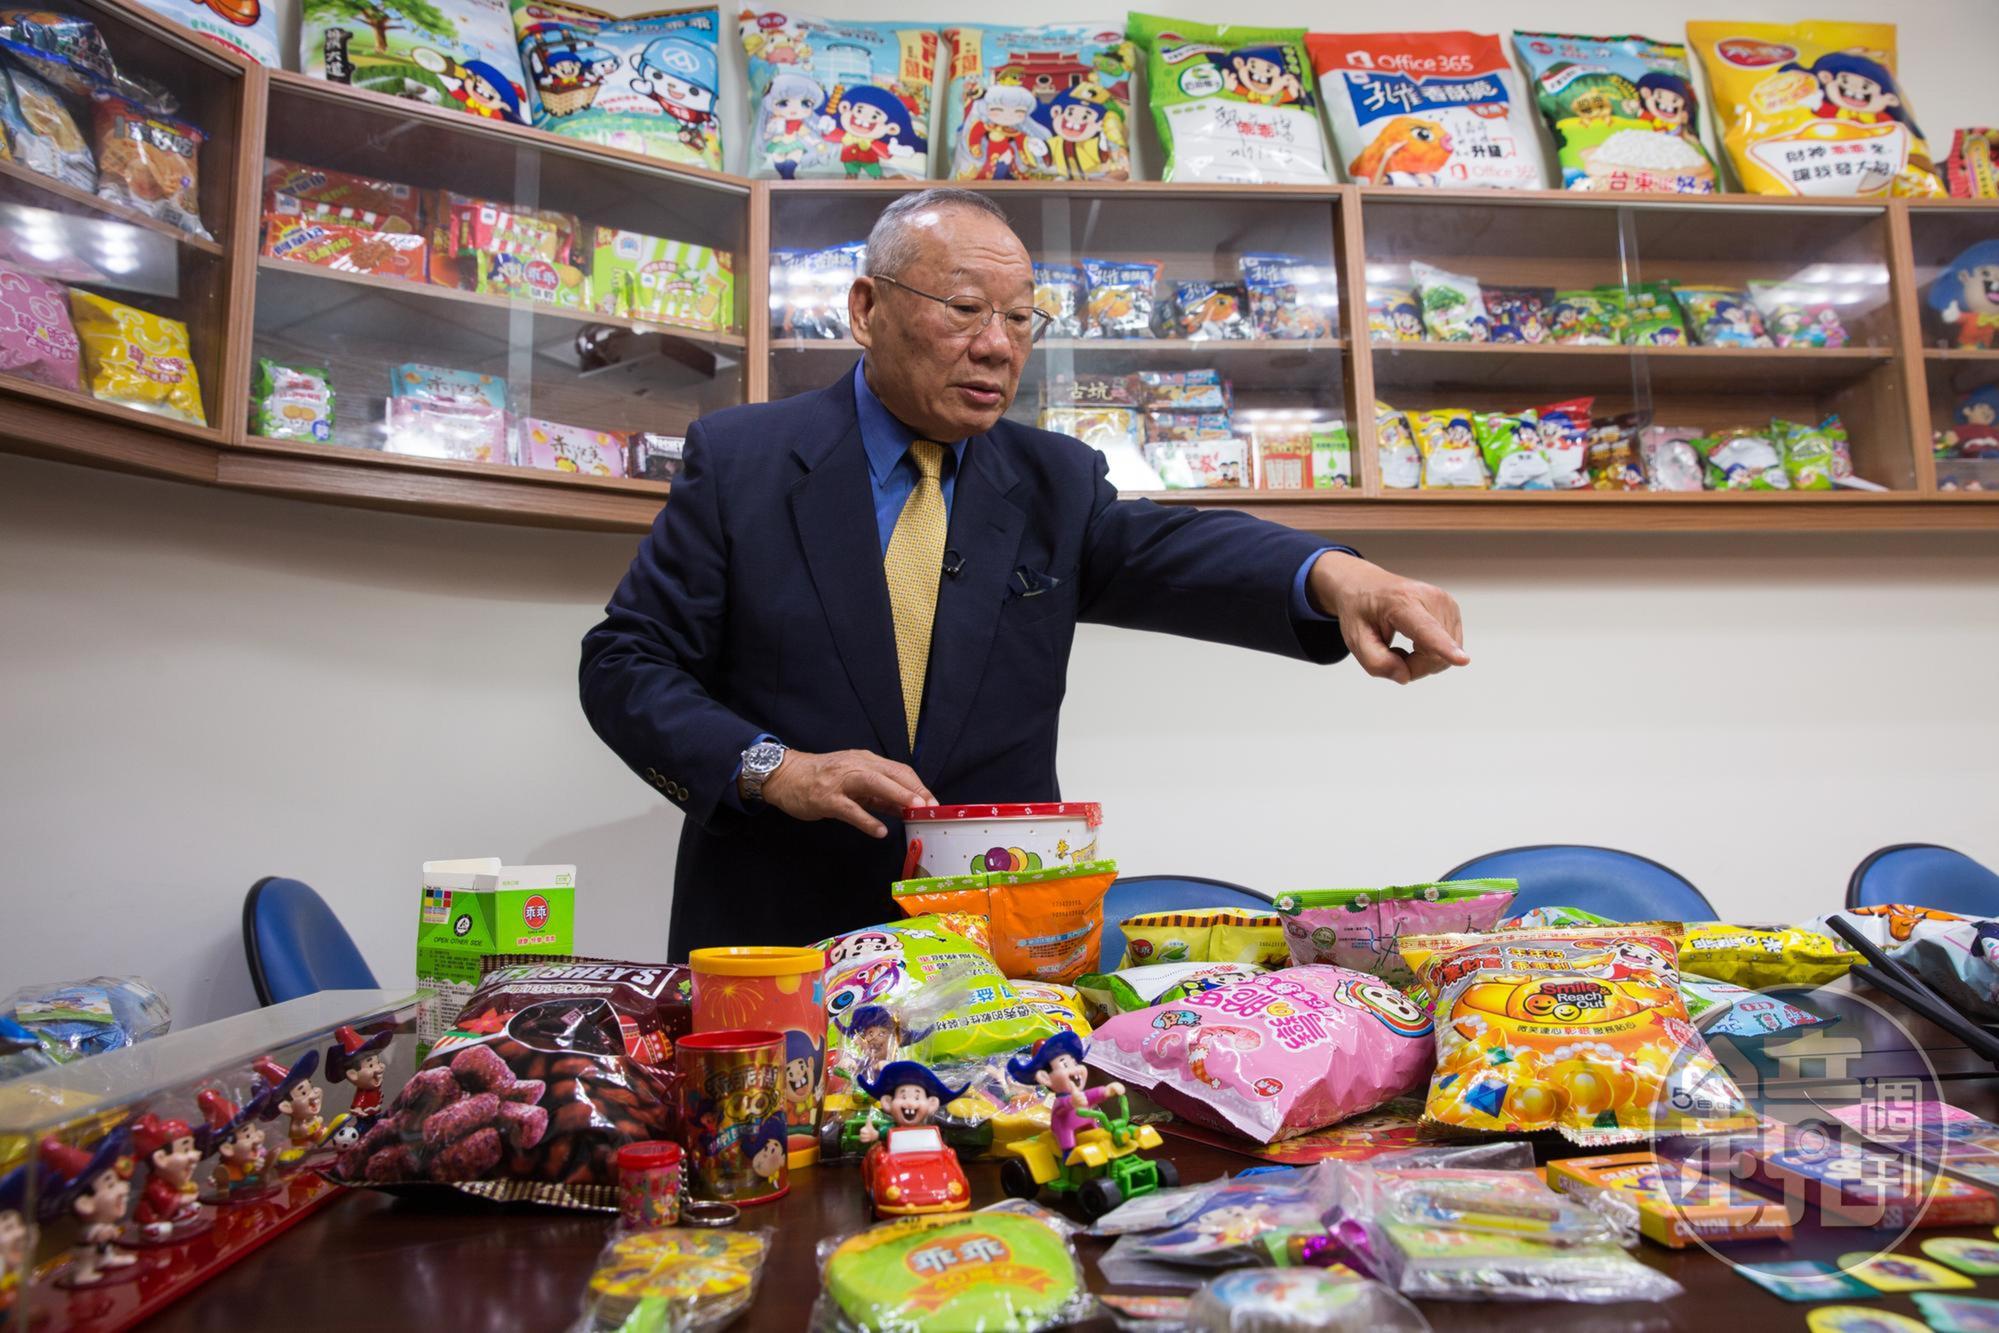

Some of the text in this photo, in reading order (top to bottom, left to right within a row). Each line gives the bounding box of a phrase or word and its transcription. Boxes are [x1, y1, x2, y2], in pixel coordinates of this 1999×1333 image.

[1378, 54, 1474, 72] Office 365
[1362, 80, 1424, 114] 孔雀
[1068, 381, 1113, 400] 古坑
[525, 904, 547, 921] 乖乖
[1540, 981, 1600, 995] Smile
[1557, 992, 1602, 1002] Reach
[1576, 1000, 1605, 1009] Out
[1675, 1218, 1728, 1236] CRAYON
[911, 1237, 1005, 1272] 乖乖
